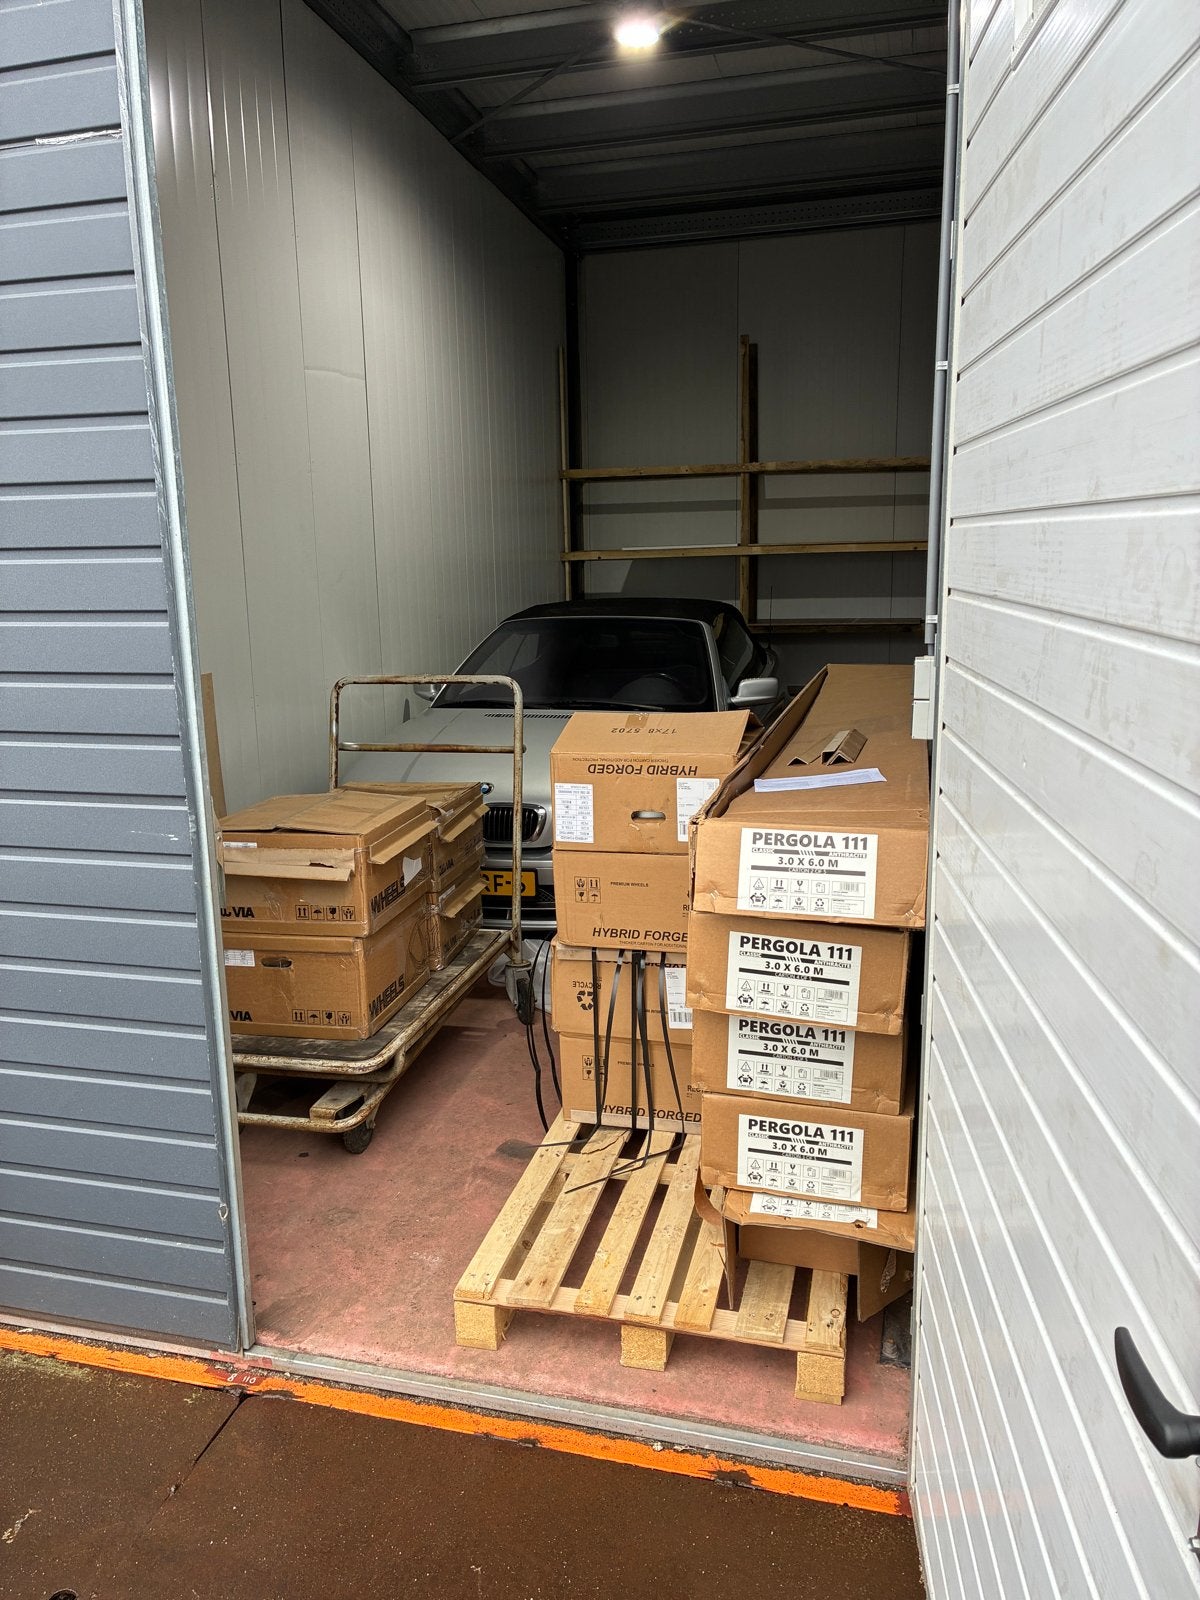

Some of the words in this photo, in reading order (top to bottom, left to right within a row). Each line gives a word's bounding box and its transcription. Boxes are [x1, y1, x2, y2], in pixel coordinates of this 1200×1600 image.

[588, 764, 643, 775] FORGED
[646, 764, 698, 776] HYBRID
[752, 832, 836, 849] PERGOLA
[842, 836, 868, 850] 111
[778, 856, 795, 866] 3.0
[798, 858, 806, 866] X
[808, 858, 826, 868] 6.0
[828, 859, 839, 868] M
[371, 875, 406, 914] WHEELS
[592, 928, 640, 940] HYBRID
[644, 930, 688, 942] FORGE
[740, 936, 821, 957] PERGOLA
[827, 946, 852, 960] 111
[765, 961, 780, 970] 3.0
[784, 964, 792, 972] X
[794, 965, 810, 974] 6.0
[813, 967, 824, 976] M
[572, 980, 602, 990] RCYCLE
[369, 973, 404, 1018] WHEELS
[739, 1019, 816, 1039] PERGOLA
[822, 1028, 846, 1043] 111
[763, 1043, 778, 1052] 3.0
[782, 1046, 788, 1054] X
[791, 1046, 806, 1055] 6.0
[809, 1048, 819, 1057] M
[602, 1104, 646, 1117] HYBRD
[748, 1119, 825, 1139] PERGOLA
[830, 1129, 854, 1142] 111
[772, 1142, 788, 1150] 3.0
[790, 1144, 797, 1152] X
[800, 1146, 815, 1154] 6.0
[818, 1148, 828, 1156] M
